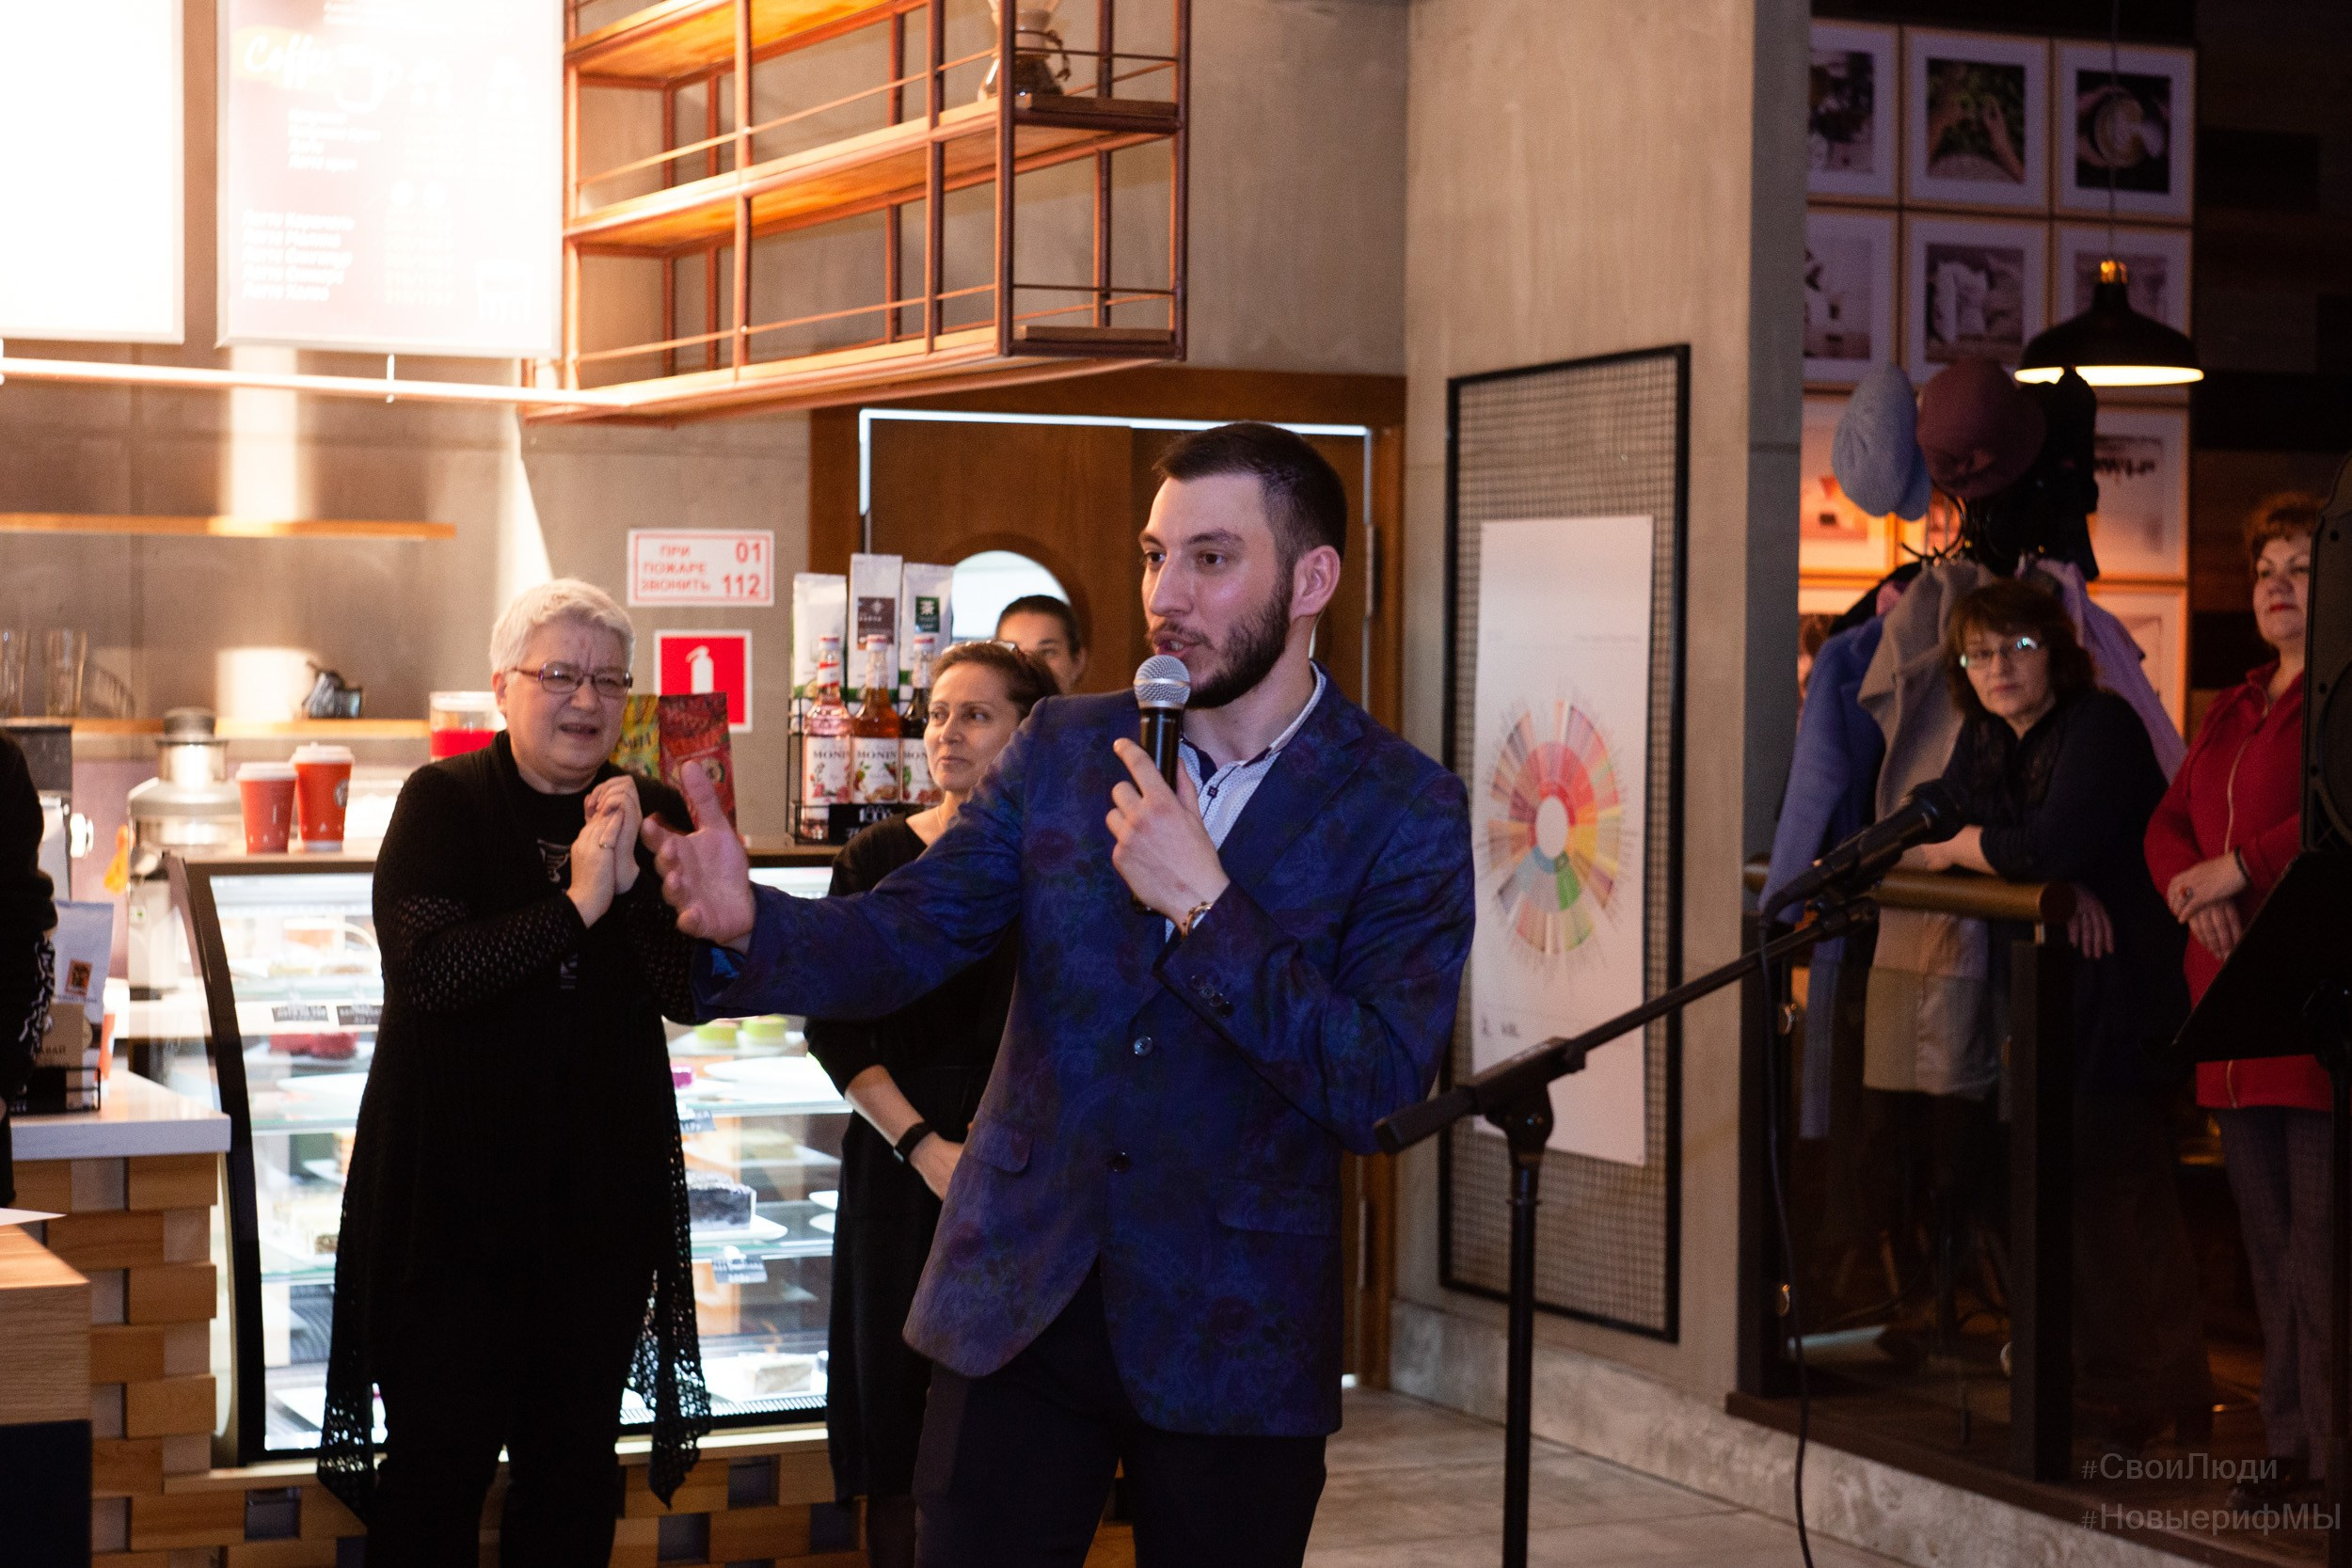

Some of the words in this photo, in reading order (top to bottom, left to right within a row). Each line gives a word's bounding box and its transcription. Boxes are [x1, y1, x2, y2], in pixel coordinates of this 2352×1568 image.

[660, 545, 691, 558] ПРИ
[736, 541, 760, 563] 01
[643, 562, 707, 573] ПОЖАРЕ
[642, 578, 710, 591] ЗВОНИТЬ
[723, 573, 760, 596] 112
